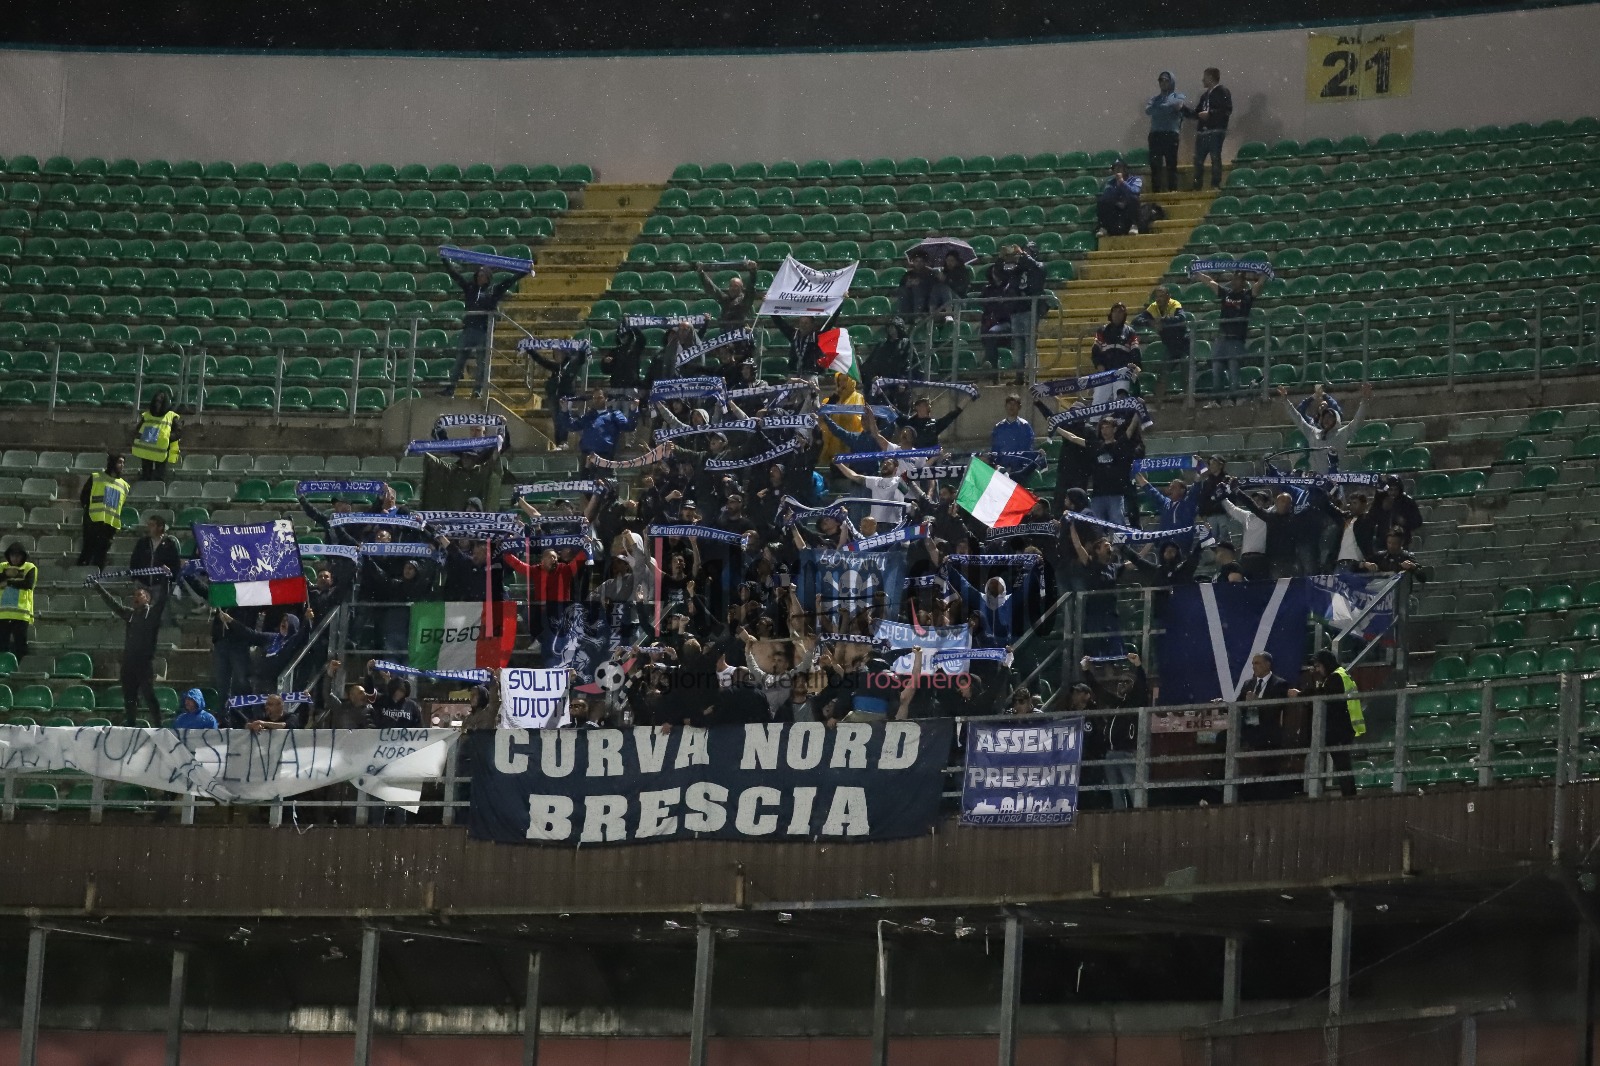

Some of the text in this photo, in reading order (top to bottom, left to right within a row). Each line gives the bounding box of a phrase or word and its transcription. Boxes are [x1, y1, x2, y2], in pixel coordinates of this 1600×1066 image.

[1320, 46, 1391, 98] 21
[680, 327, 743, 362] BRESCIA
[1054, 385, 1075, 393] CALCIO
[345, 482, 373, 491] NORD
[218, 525, 266, 535] La Ciurma
[384, 545, 433, 556] BERGAMO
[508, 669, 570, 692] SOLITI
[227, 690, 309, 707] BRSCIA
[511, 696, 567, 718] IDIOTI
[379, 728, 429, 743] CURVA
[975, 726, 1077, 754] ASSENTI
[493, 721, 922, 779] CURVA NORD
[968, 764, 1078, 789] PRESENTI
[524, 781, 871, 843] BRESCIA
[962, 813, 994, 824] CURVA
[1025, 812, 1072, 823] BRESCIA
